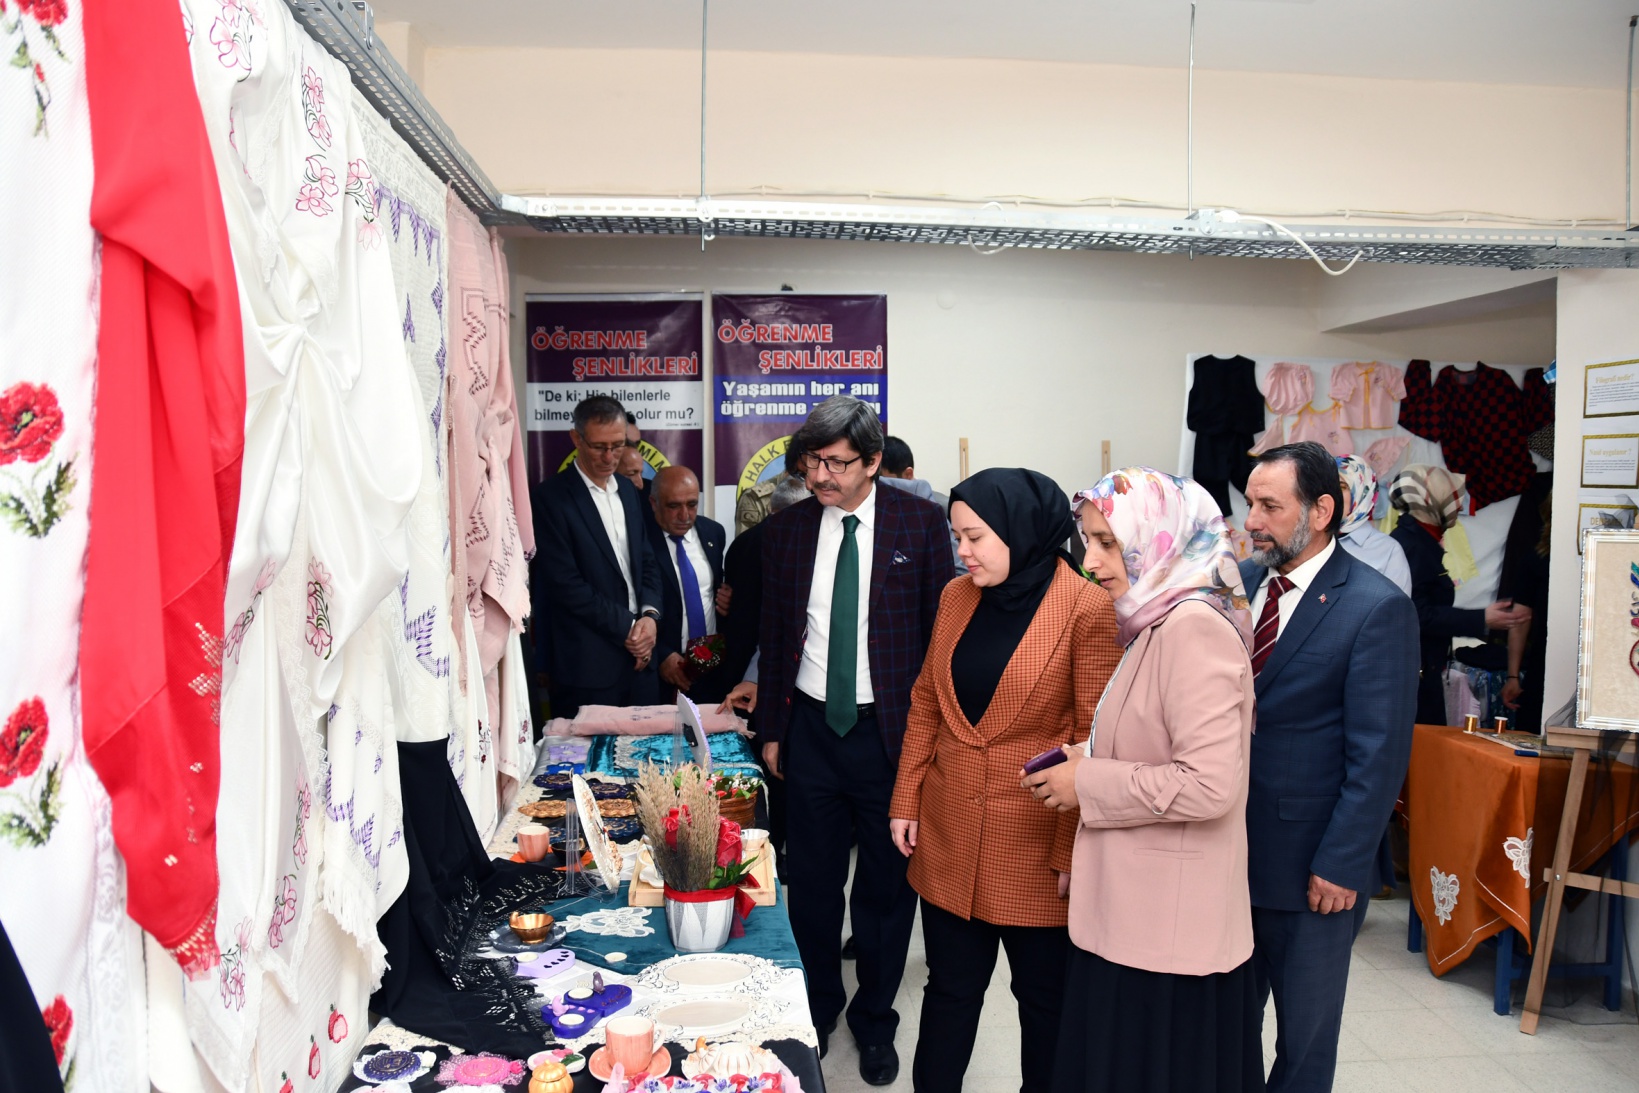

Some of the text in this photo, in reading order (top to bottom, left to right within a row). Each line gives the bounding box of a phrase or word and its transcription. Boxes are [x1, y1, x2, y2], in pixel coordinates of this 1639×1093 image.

[531, 326, 647, 350] ÖĞRENME
[717, 319, 833, 343] ÖĞRENME
[572, 351, 698, 381] ŞENLİKLERİ
[759, 345, 883, 374] ŞENLİKLERİ
[538, 390, 562, 402] "De
[611, 388, 671, 402] bilenlerle
[722, 380, 879, 398] Yaşamın her anı
[636, 408, 662, 420] olur
[665, 407, 694, 420] mu?
[720, 400, 807, 418] öğrenme
[745, 445, 780, 482] HALK
